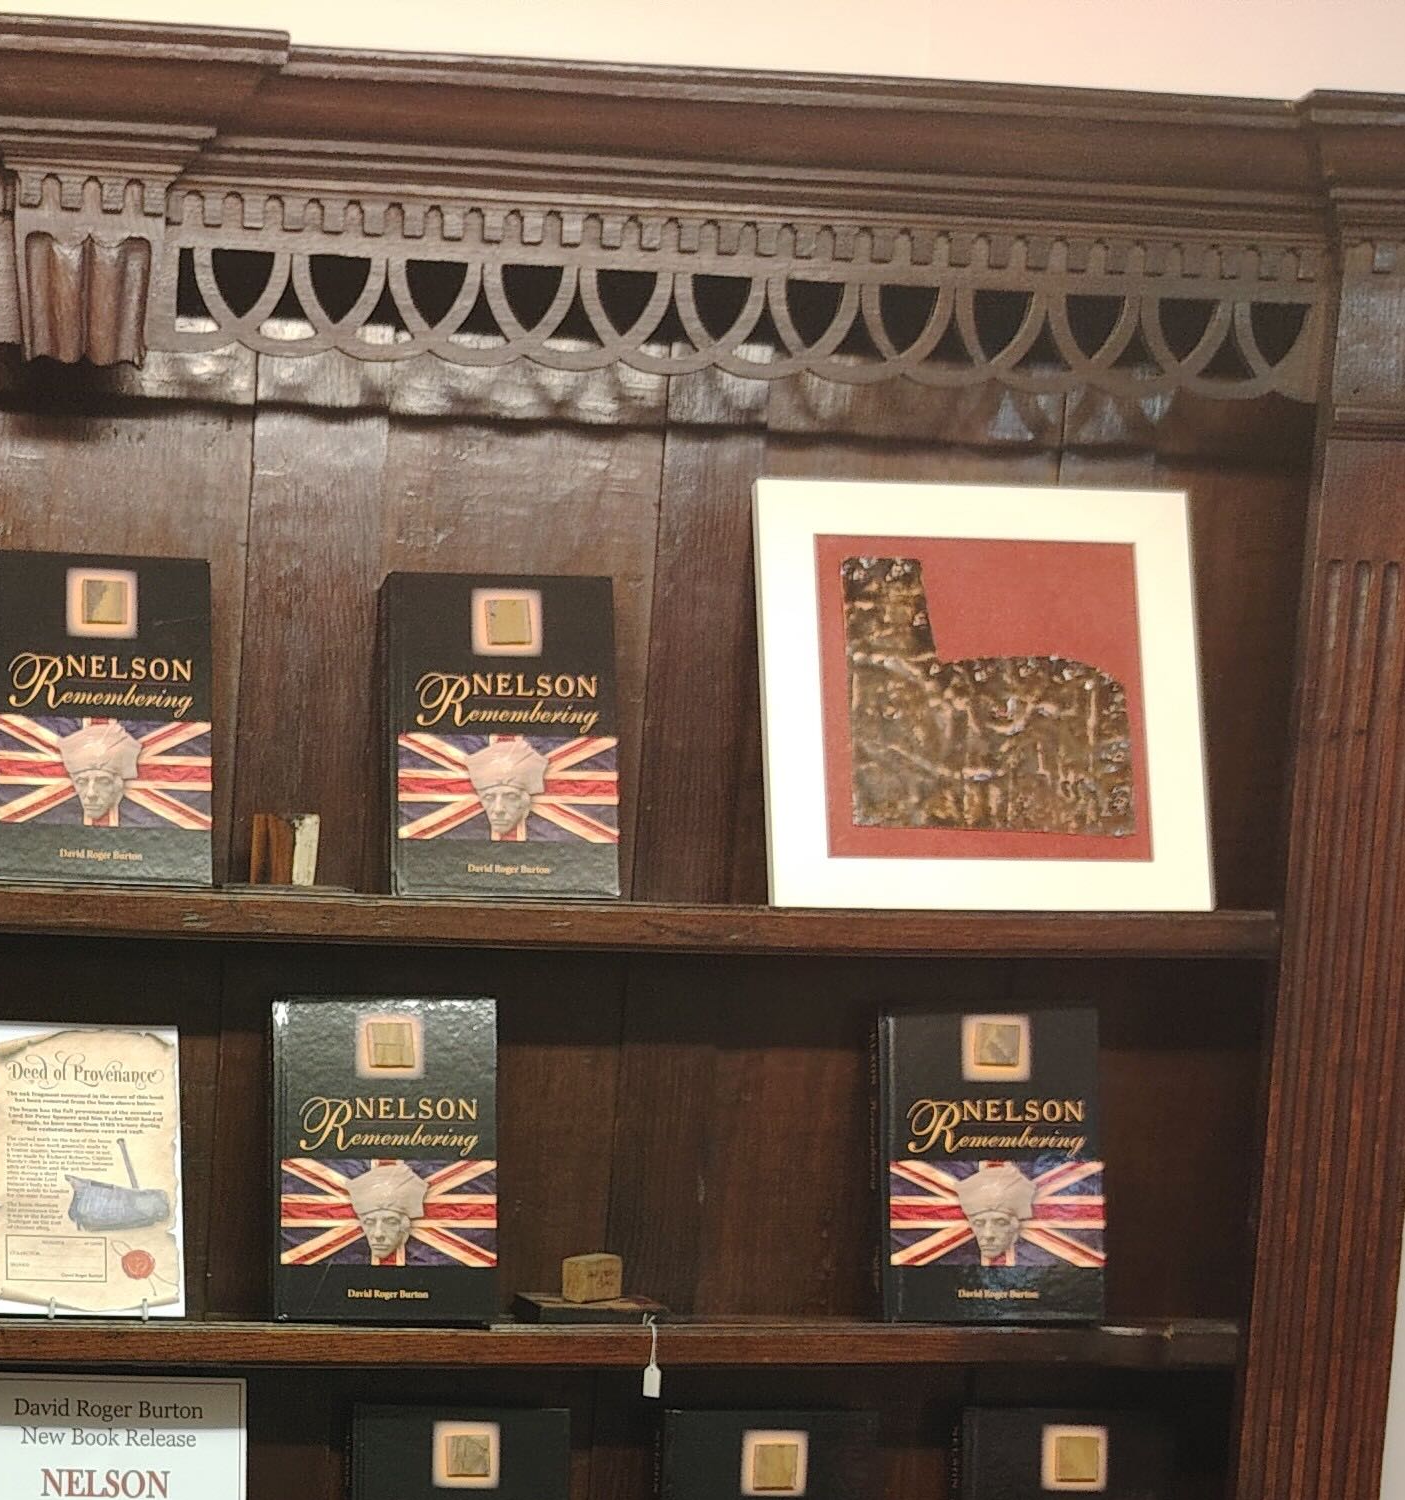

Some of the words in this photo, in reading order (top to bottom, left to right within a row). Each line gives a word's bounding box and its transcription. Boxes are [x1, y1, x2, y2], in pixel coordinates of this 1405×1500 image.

[66, 655, 192, 682] NELSON
[8, 652, 194, 718] Remembering
[472, 673, 597, 698] NELSON
[415, 672, 599, 734] Remembering
[5, 1055, 54, 1089] Deed
[73, 1061, 164, 1090] Provenance
[354, 1098, 478, 1121] NELSON
[962, 1100, 1084, 1122] NELSON
[299, 1096, 479, 1156] Remembering
[907, 1100, 1087, 1157] Remembering
[347, 1289, 373, 1298] David
[374, 1289, 398, 1300] Roger
[399, 1290, 428, 1299] Burton
[14, 1398, 70, 1416] David
[77, 1400, 133, 1422] Roger
[139, 1401, 203, 1419] Burton
[21, 1427, 65, 1445] New
[71, 1427, 120, 1446] Book
[126, 1428, 196, 1447] Release
[41, 1468, 170, 1498] NELSON
